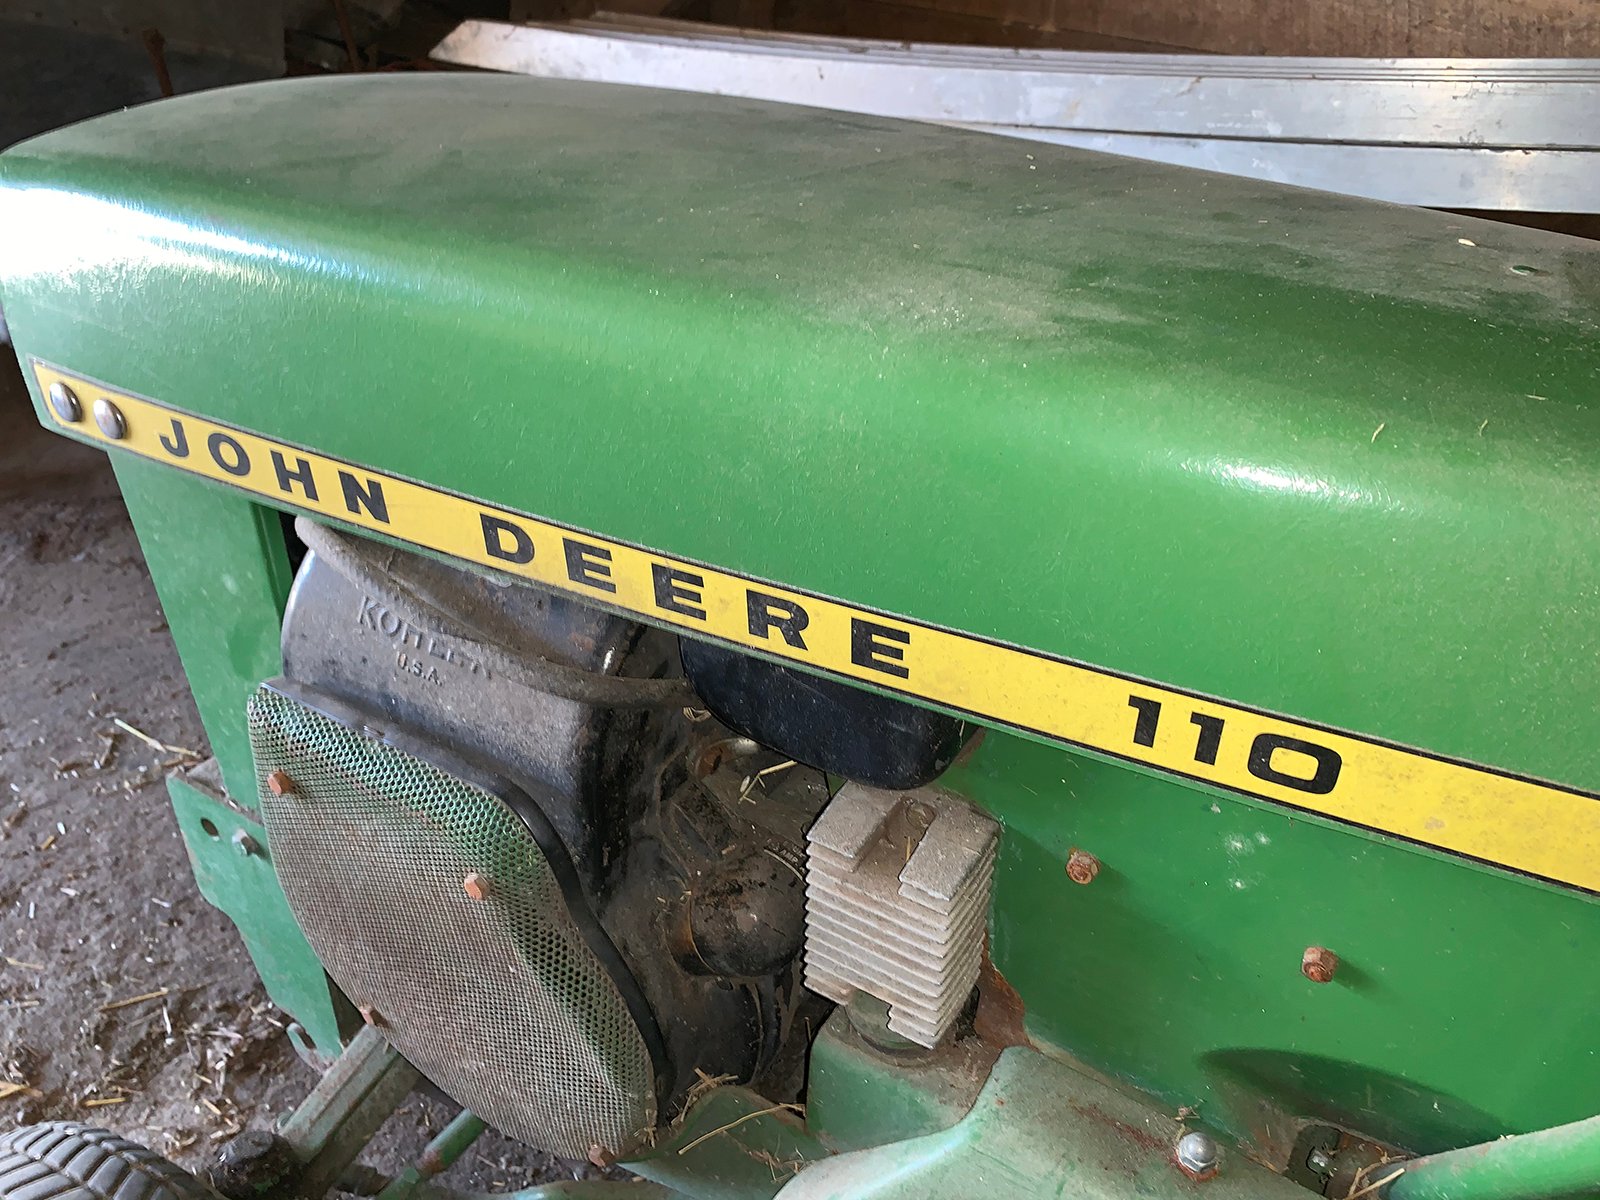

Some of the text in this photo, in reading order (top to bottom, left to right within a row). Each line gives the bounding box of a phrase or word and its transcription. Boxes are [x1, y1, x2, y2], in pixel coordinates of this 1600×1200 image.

[159, 417, 1342, 794] JOHN DEERE 110
[357, 596, 492, 680] KOHL
[396, 651, 442, 687] U.S.A.
